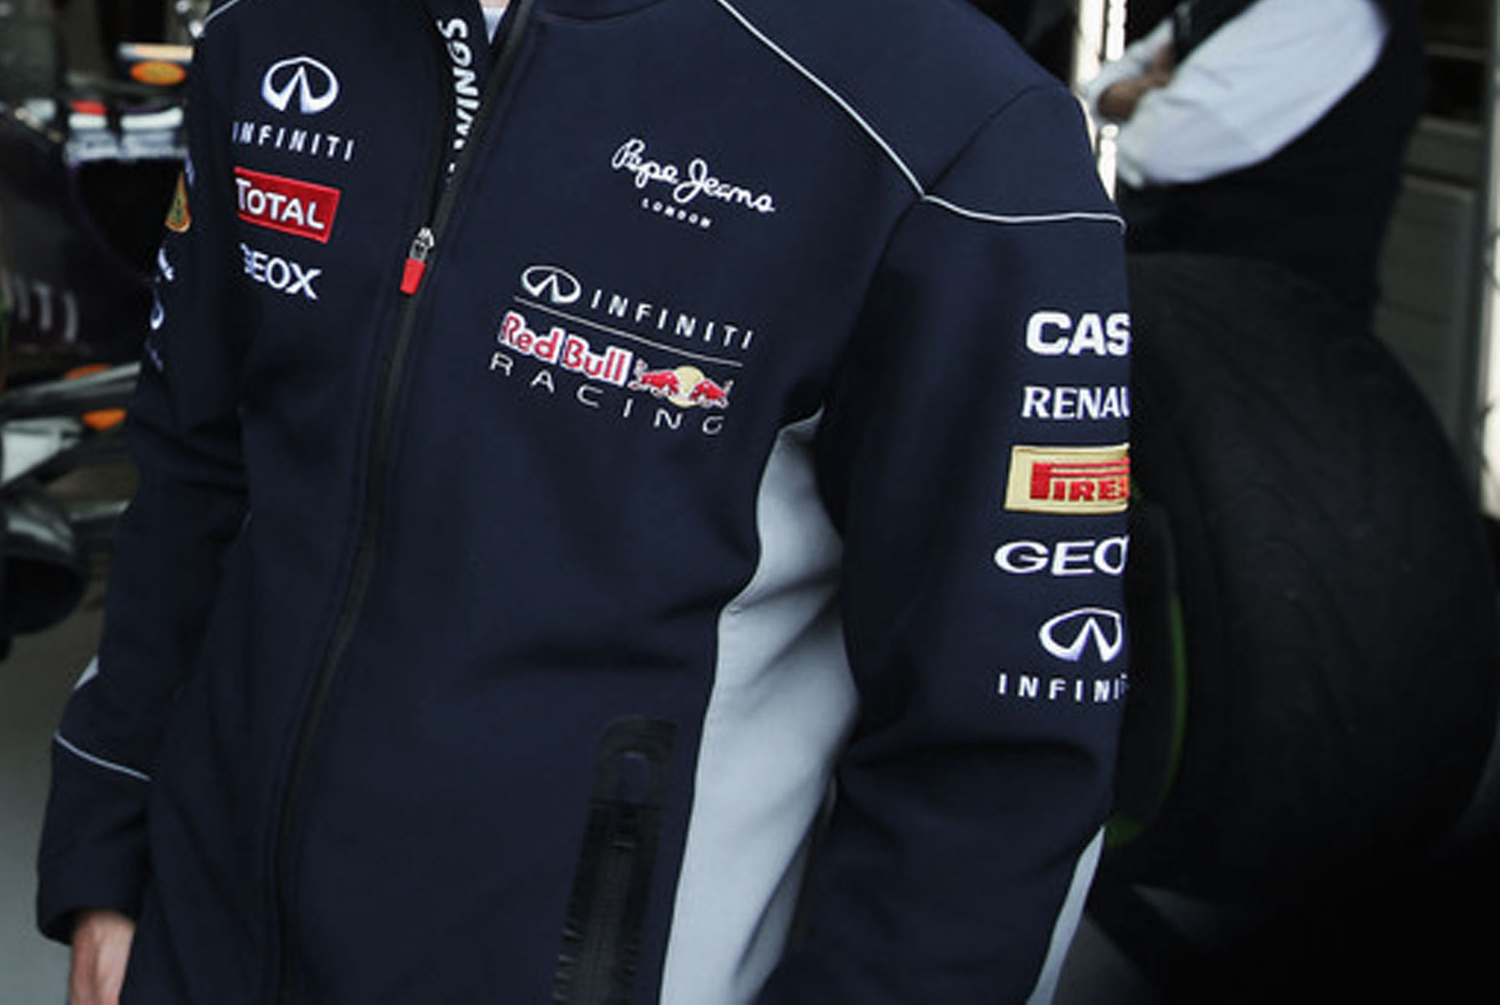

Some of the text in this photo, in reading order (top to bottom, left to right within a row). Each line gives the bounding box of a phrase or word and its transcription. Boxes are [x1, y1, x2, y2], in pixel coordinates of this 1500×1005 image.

[232, 121, 354, 161] INFINITI
[612, 138, 775, 212] Pepe Jeans
[235, 178, 325, 229] TOTAL
[641, 197, 710, 228] LONDON
[591, 289, 753, 349] INFINITI
[1026, 311, 1131, 356] CAS
[489, 352, 724, 434] RACING
